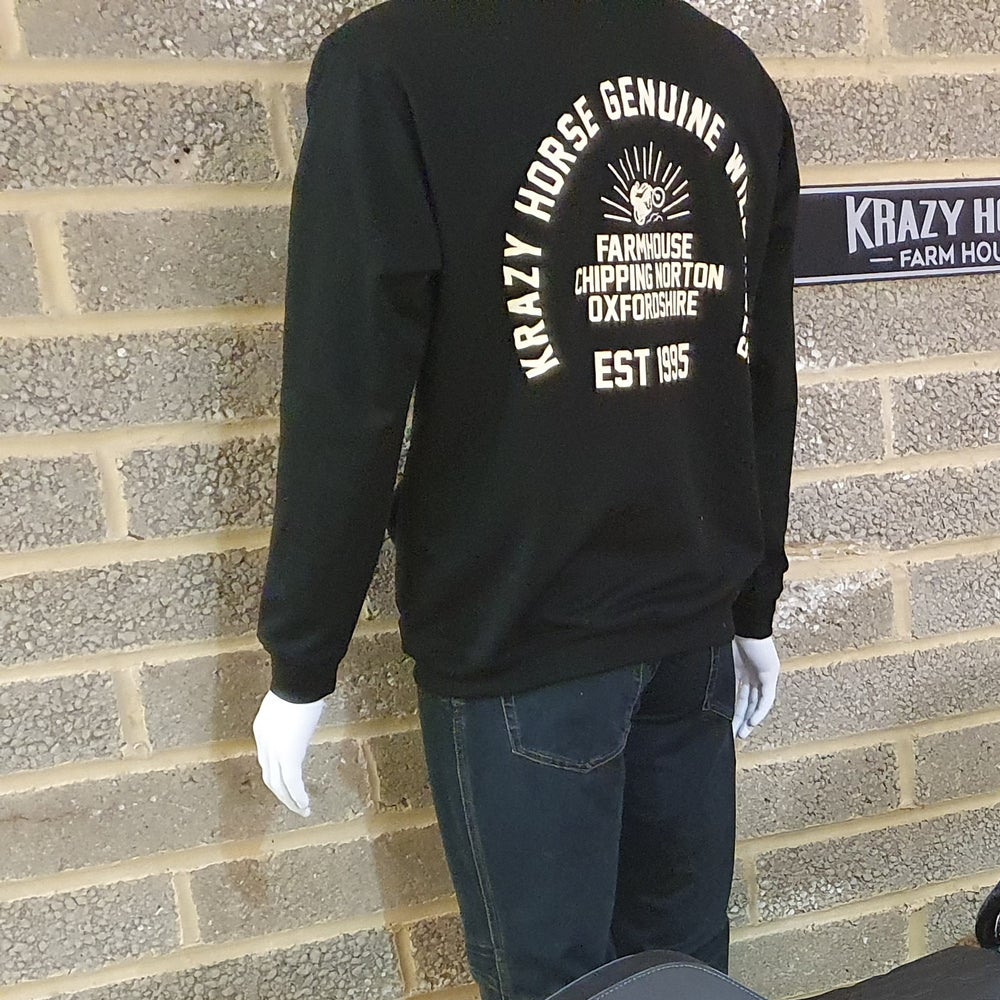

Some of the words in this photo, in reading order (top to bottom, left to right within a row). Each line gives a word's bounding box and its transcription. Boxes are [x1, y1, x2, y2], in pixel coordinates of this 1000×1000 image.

[599, 75, 726, 152] GENUINE
[514, 95, 600, 222] HORSE
[595, 232, 694, 263] FARMHOUSE
[845, 195, 965, 255] KRAZY
[574, 263, 653, 296] CHIPPING
[655, 261, 725, 291] NORTON
[900, 248, 955, 268] FARM
[503, 232, 561, 380] KRAZY
[587, 290, 700, 323] OXFORDSHIRE
[594, 348, 651, 389] EST
[656, 342, 691, 384] 1995
